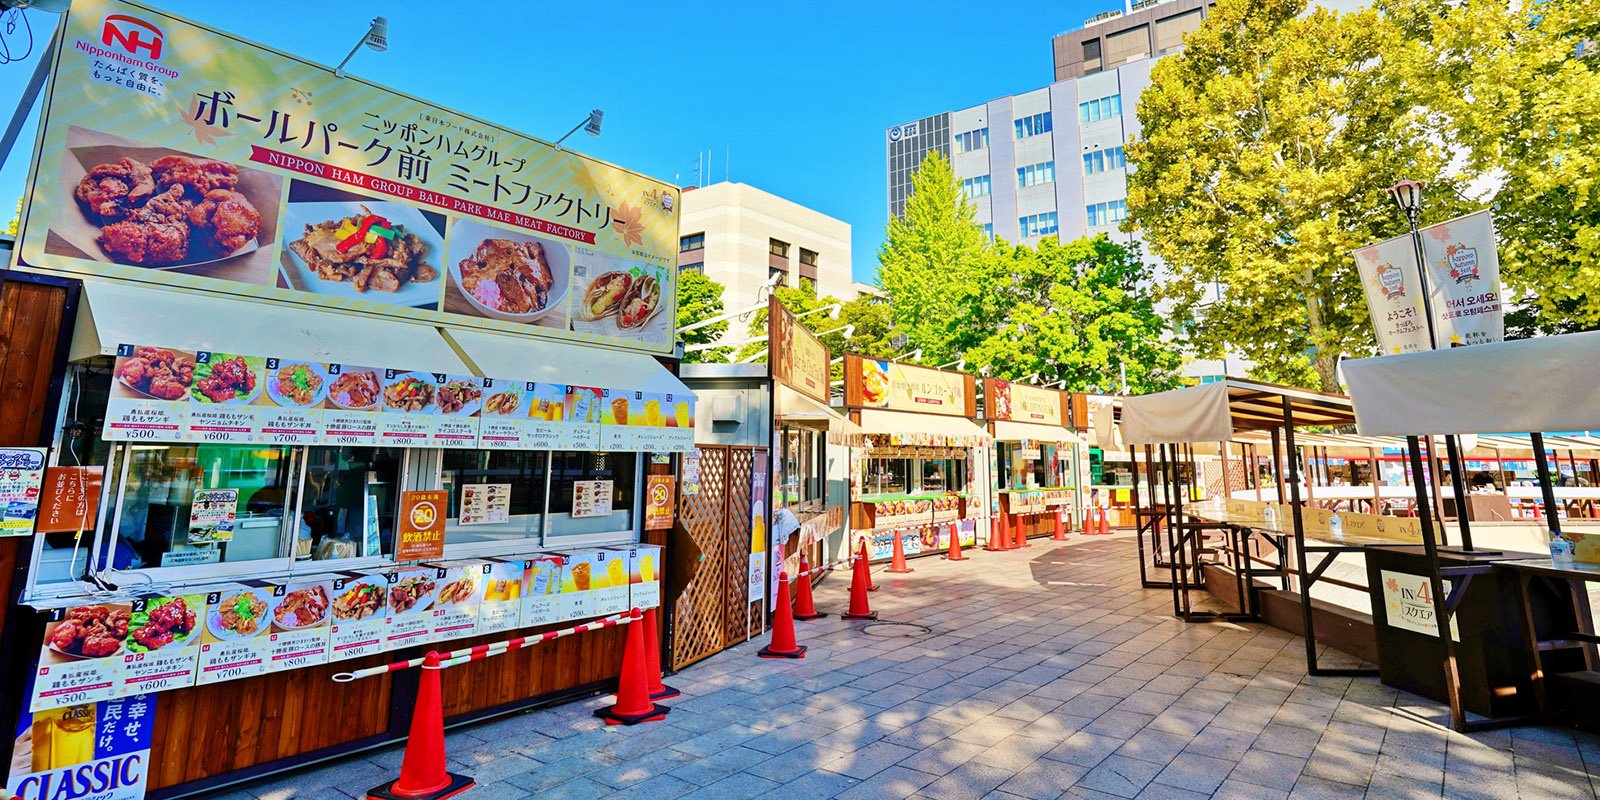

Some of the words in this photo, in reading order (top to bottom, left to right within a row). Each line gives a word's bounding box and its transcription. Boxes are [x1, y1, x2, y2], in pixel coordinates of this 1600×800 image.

[76, 40, 143, 68] Nipponham
[145, 61, 179, 79] Group
[94, 60, 163, 87] たんぱく質を、
[93, 70, 161, 96] もっと自由に。
[362, 111, 527, 173] ニッポンハムグループ
[193, 90, 433, 185] ボールパーク前
[447, 163, 626, 230] ミートファクトリー
[269, 151, 325, 176] NIPPON
[332, 168, 364, 186] HAM
[370, 179, 414, 198] GROUP
[418, 190, 449, 207] BALL
[453, 198, 482, 215] PARK
[487, 207, 511, 222] MAE
[515, 213, 543, 231] MEAT
[546, 222, 586, 241] FACTORY
[1446, 297, 1465, 309] 어서
[1466, 292, 1499, 306] 오세요!
[125, 429, 155, 439] ¥500
[204, 432, 230, 441] ¥600
[274, 434, 297, 443] ¥700
[337, 436, 358, 444] ¥800
[393, 437, 412, 445] ¥800
[66, 473, 78, 502] こちらに
[1401, 587, 1414, 600] IN
[1416, 581, 1433, 604] 4
[1405, 606, 1433, 620] スクエア
[343, 647, 364, 657] ¥800
[283, 656, 306, 668] ¥800
[216, 667, 242, 680] ¥700
[139, 679, 167, 692] ¥600
[55, 691, 87, 705] ¥500
[15, 754, 141, 800] CLASSIC
